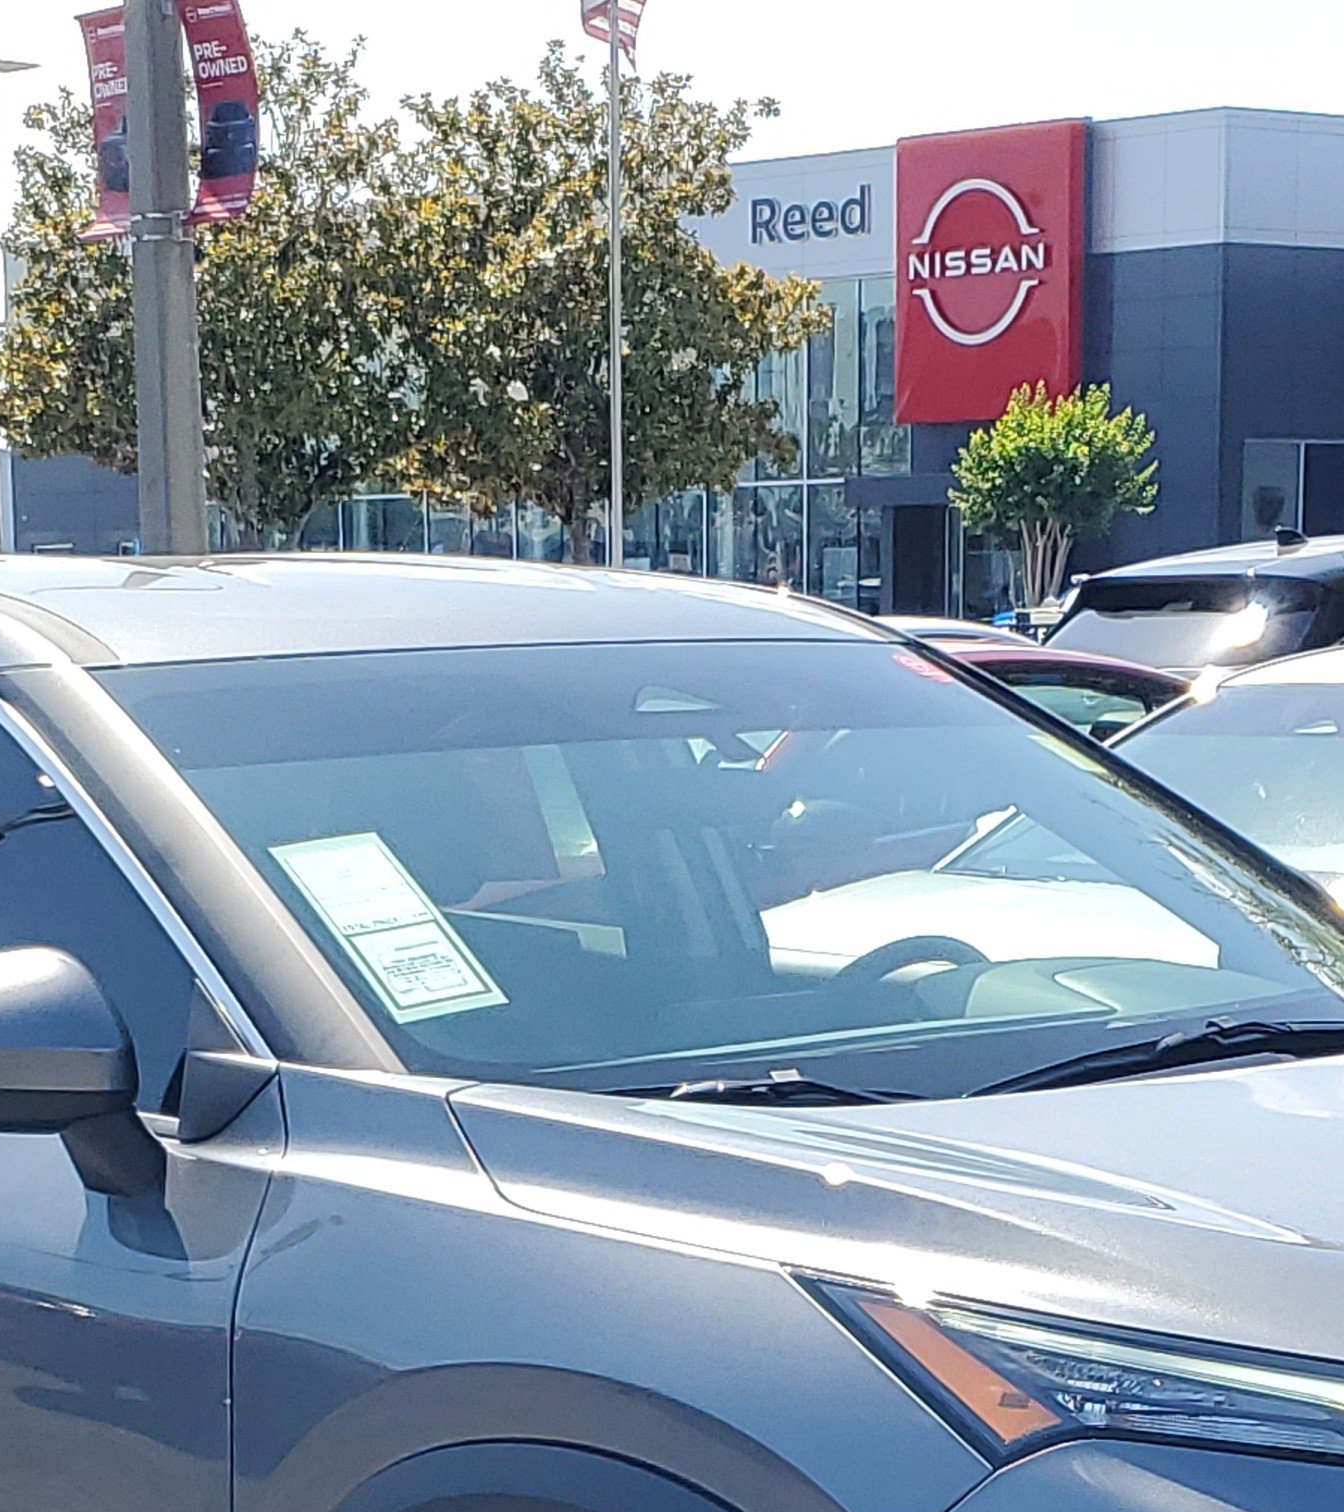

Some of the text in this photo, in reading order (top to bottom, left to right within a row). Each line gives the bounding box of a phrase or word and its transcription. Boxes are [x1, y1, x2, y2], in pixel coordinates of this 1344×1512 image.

[193, 40, 227, 61] PRE-
[91, 61, 118, 80] PRE-
[198, 55, 248, 79] OWNED
[751, 184, 869, 245] Reed
[908, 241, 1045, 281] NISSAN
